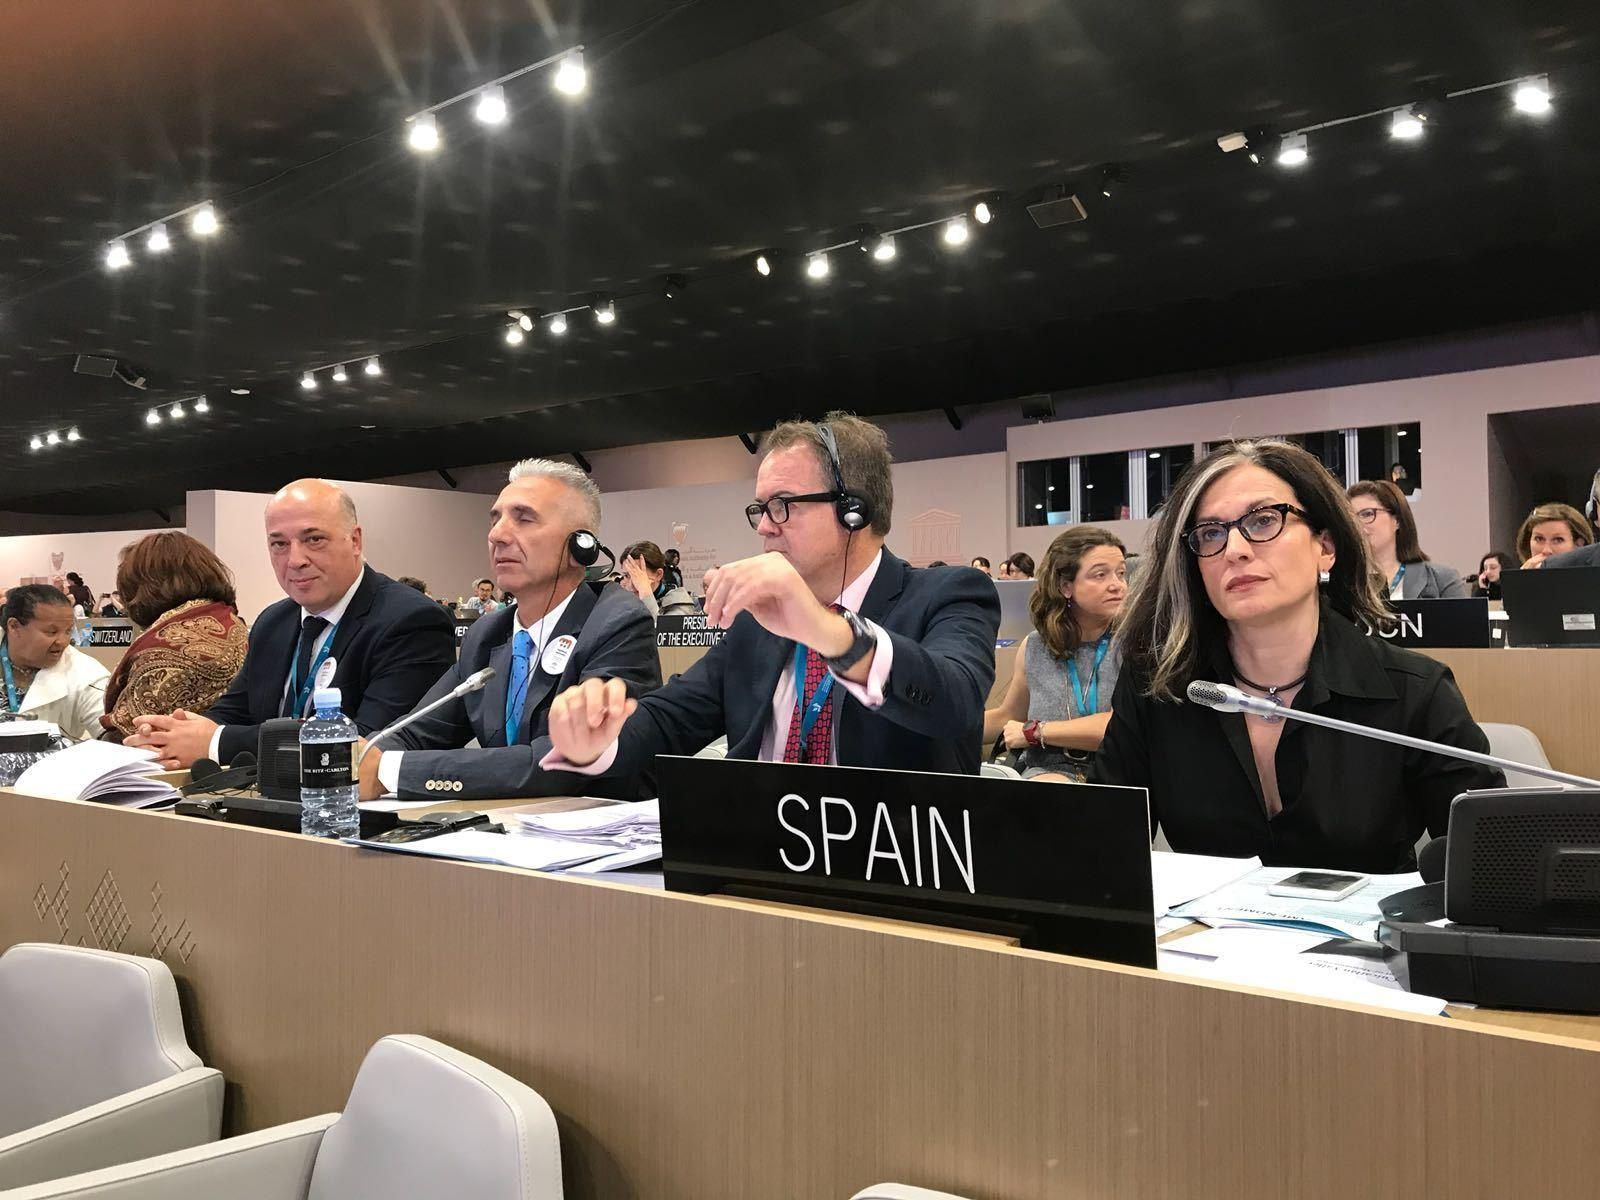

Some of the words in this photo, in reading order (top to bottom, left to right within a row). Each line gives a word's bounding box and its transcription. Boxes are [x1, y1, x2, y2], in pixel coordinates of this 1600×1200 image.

[90, 630, 133, 643] SWITZERLAND
[657, 633, 667, 646] OF
[668, 633, 681, 646] THE
[777, 793, 976, 895] SPAIN
